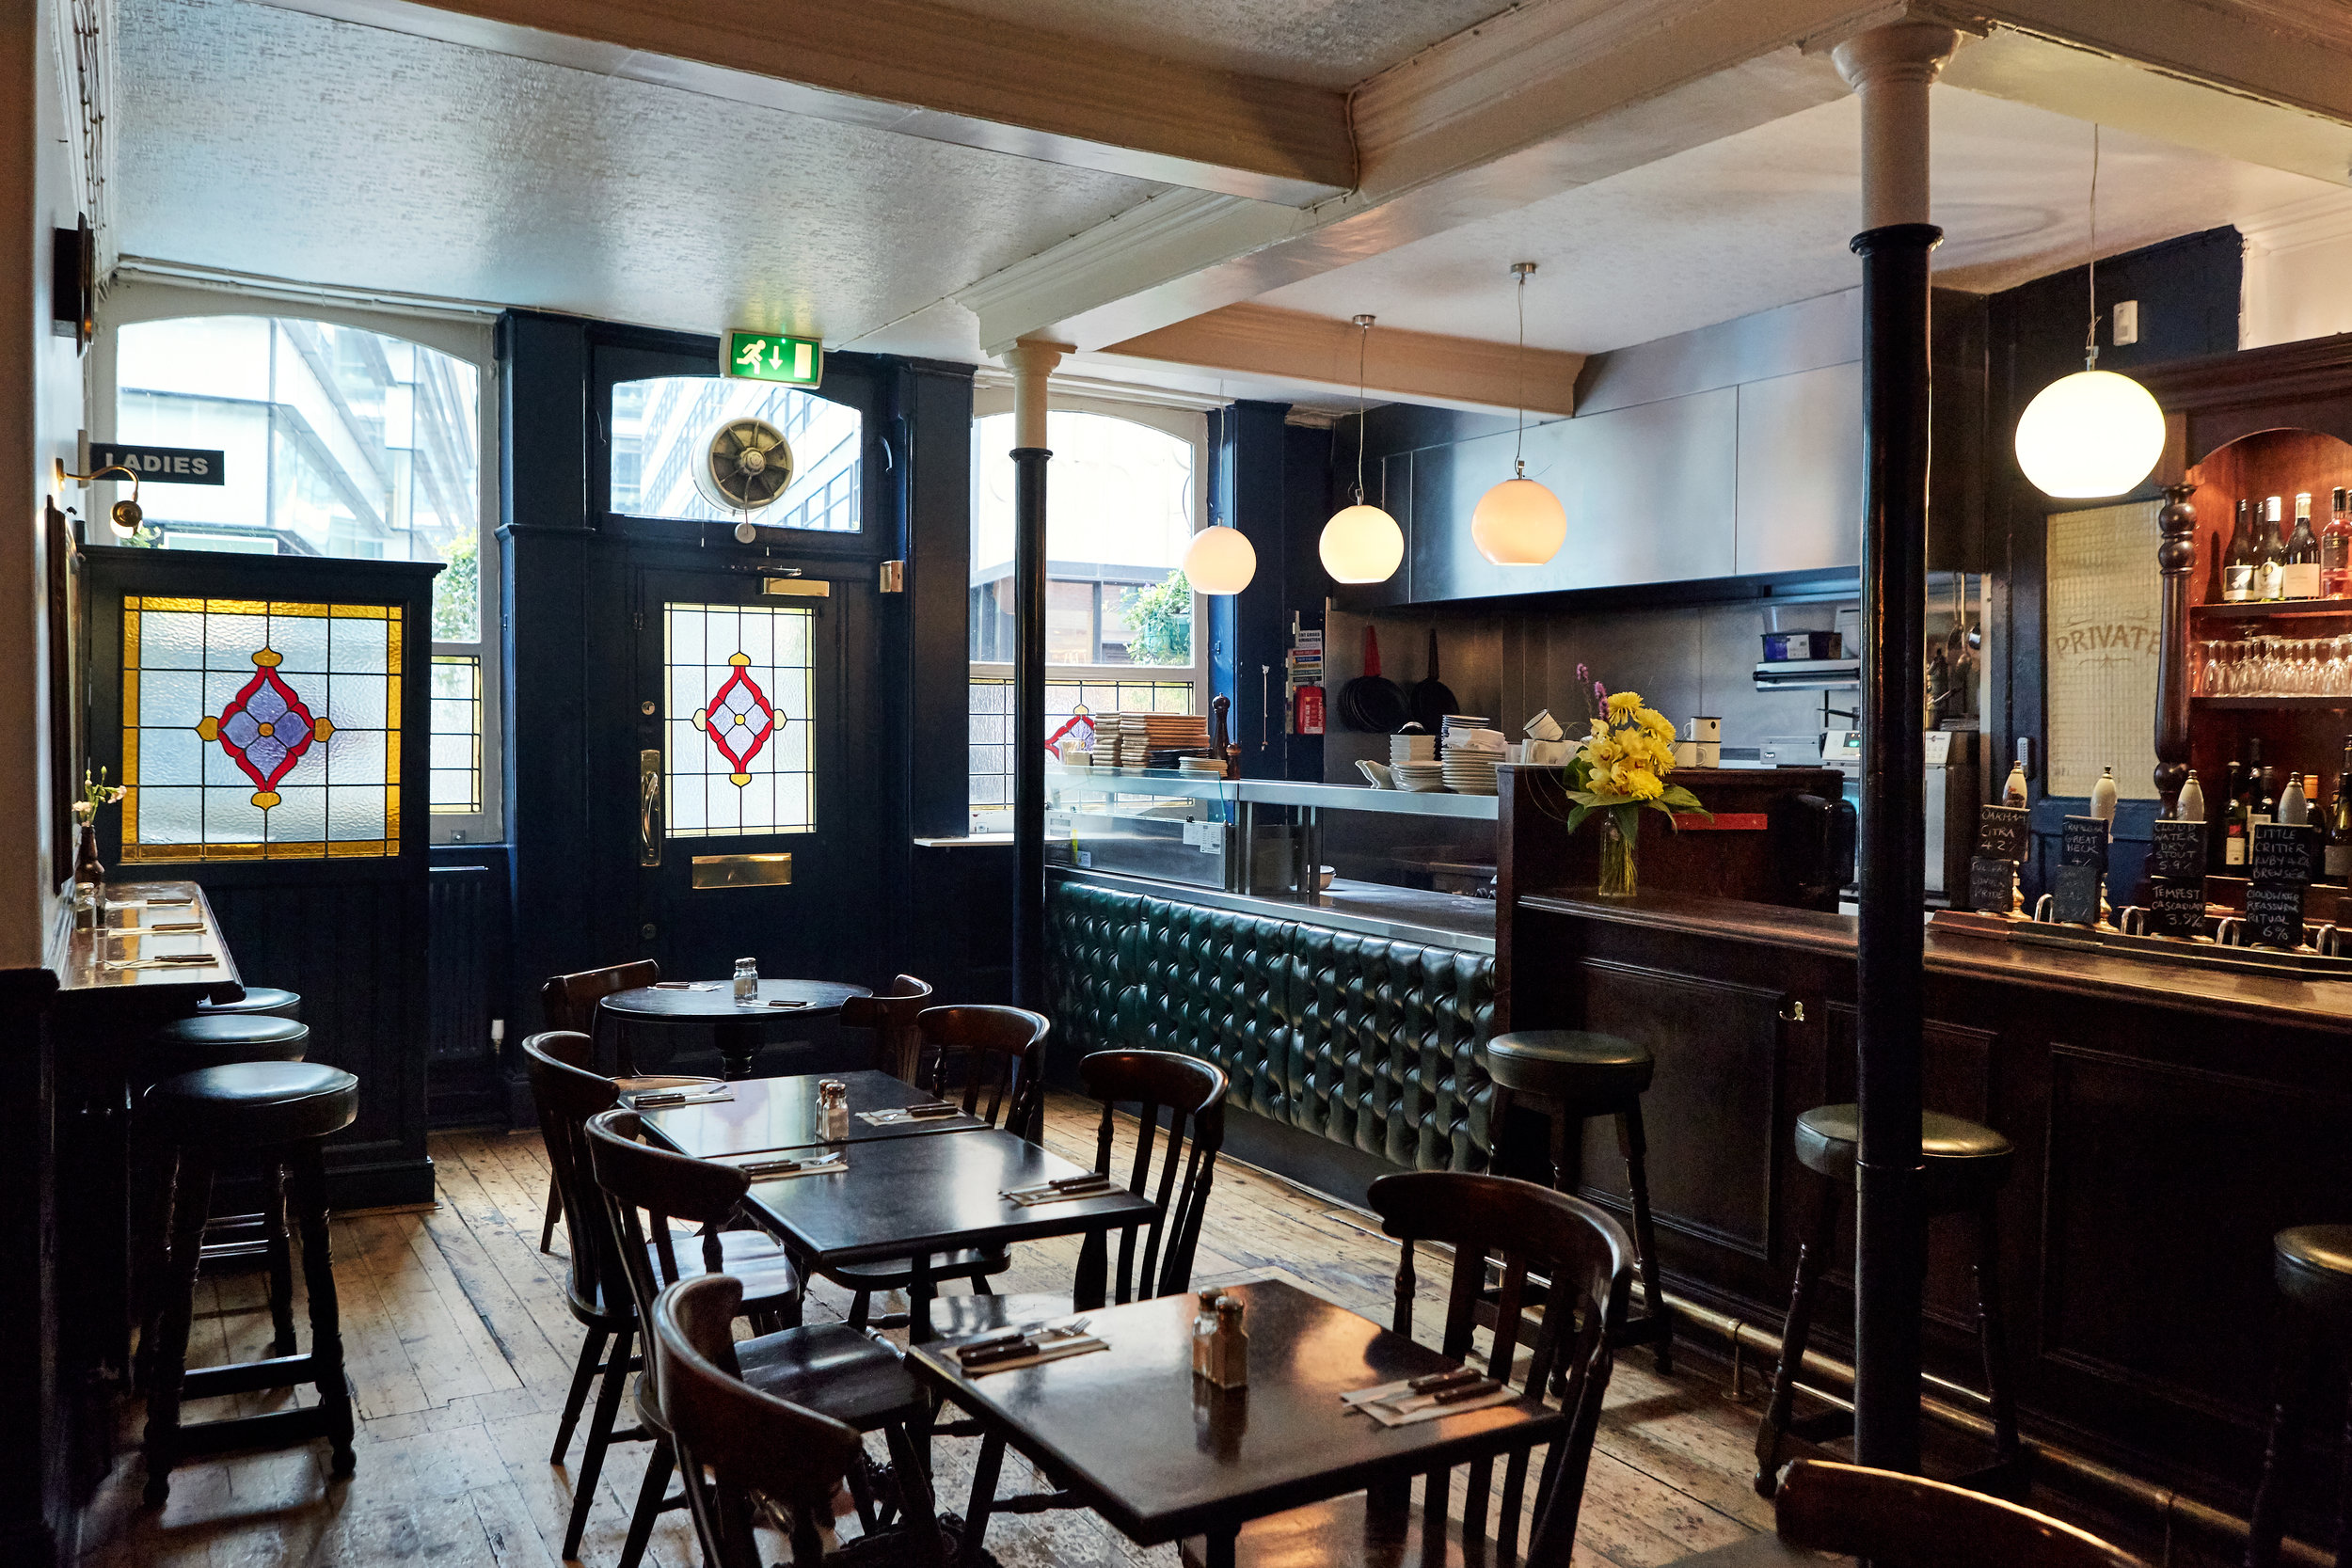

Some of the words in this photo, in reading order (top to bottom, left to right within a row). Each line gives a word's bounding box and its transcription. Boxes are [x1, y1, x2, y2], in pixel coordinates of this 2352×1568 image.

[1980, 824, 2014, 838] CITRA
[2153, 823, 2197, 832] CLOUD
[2064, 834, 2098, 845] GREAT
[2153, 832, 2199, 843] WATER
[2255, 828, 2296, 840] LITTLE
[2067, 844, 2099, 854] HECK
[2161, 843, 2186, 851] DRY
[2255, 842, 2310, 857] CRITTER
[2155, 850, 2196, 859] STOUT
[2254, 856, 2284, 867] RUBY
[2152, 886, 2201, 900] TEMPEST
[2247, 913, 2290, 925] RITUAL
[2263, 926, 2289, 941] 6%
